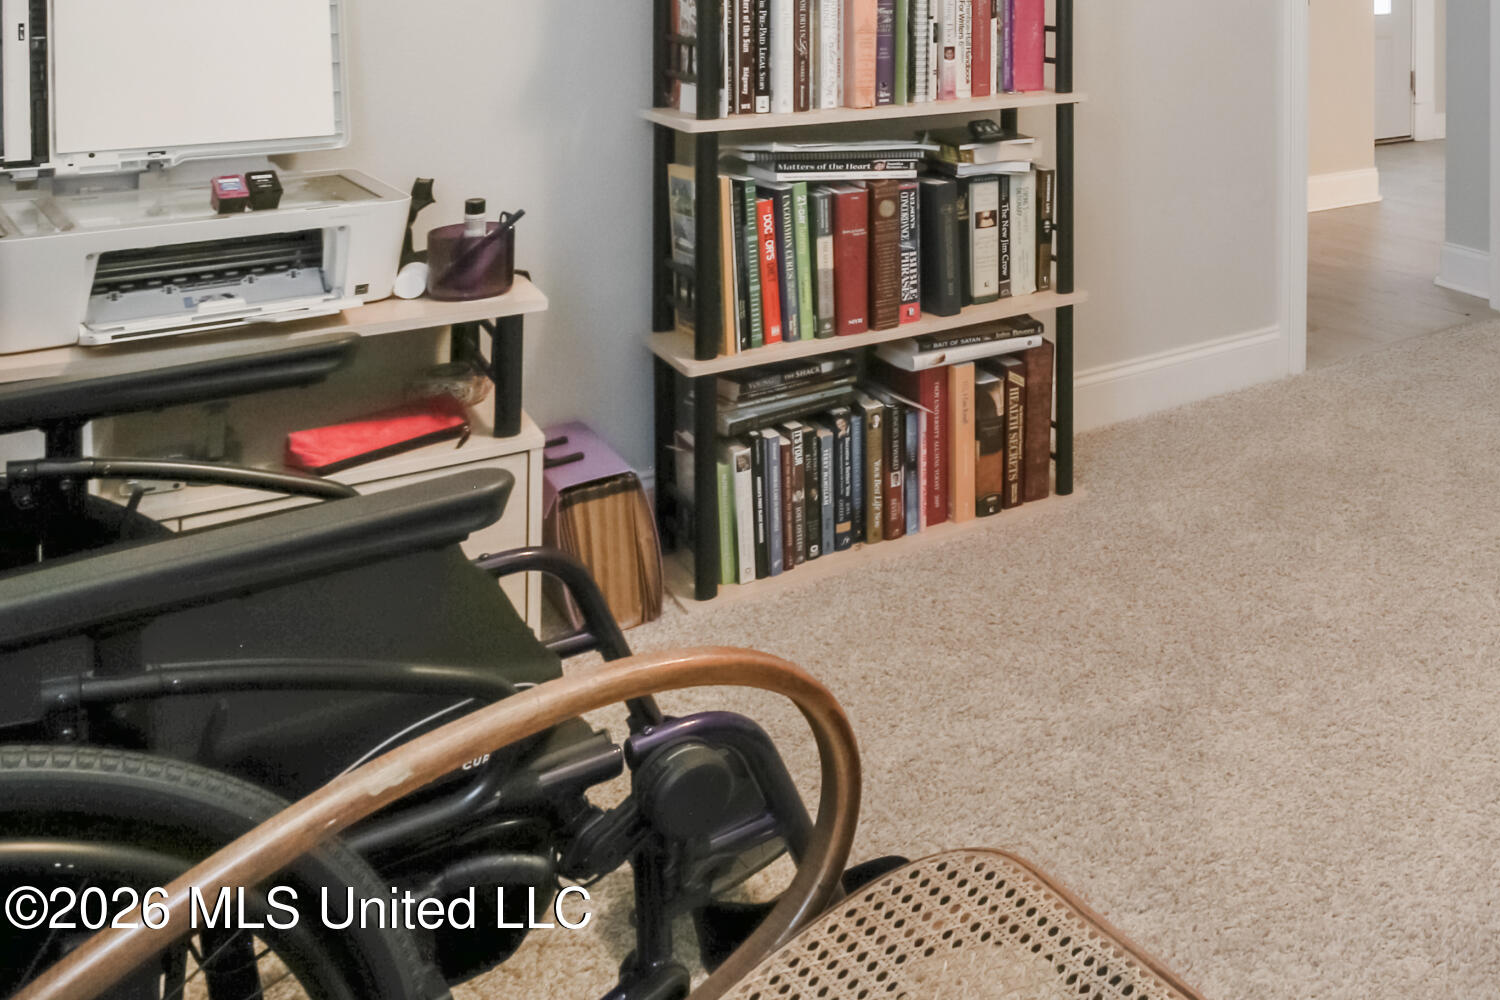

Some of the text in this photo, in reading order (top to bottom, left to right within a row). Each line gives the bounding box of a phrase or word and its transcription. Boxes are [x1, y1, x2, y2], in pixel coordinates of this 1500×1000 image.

[742, 15, 751, 24] of
[799, 13, 807, 39] DRIVEN
[958, 13, 966, 40] Writers
[742, 24, 751, 38] the
[742, 38, 751, 53] Sun
[778, 163, 871, 171] Matters of the Heart
[900, 191, 910, 241] CONCORDANCE
[782, 194, 794, 281] UNCOMMON CURES
[1000, 203, 1009, 276] The New Jim Crow
[900, 251, 911, 303] PHRASES
[909, 250, 918, 300] BIBLE
[932, 342, 949, 350] BAIT
[960, 337, 982, 346] SATAN
[795, 366, 822, 379] SHACK
[794, 430, 803, 444] IT'S
[1007, 387, 1020, 482] HEALTH SECRETS
[794, 444, 804, 465] YOUR
[874, 479, 882, 495] Best
[872, 495, 882, 511] Life
